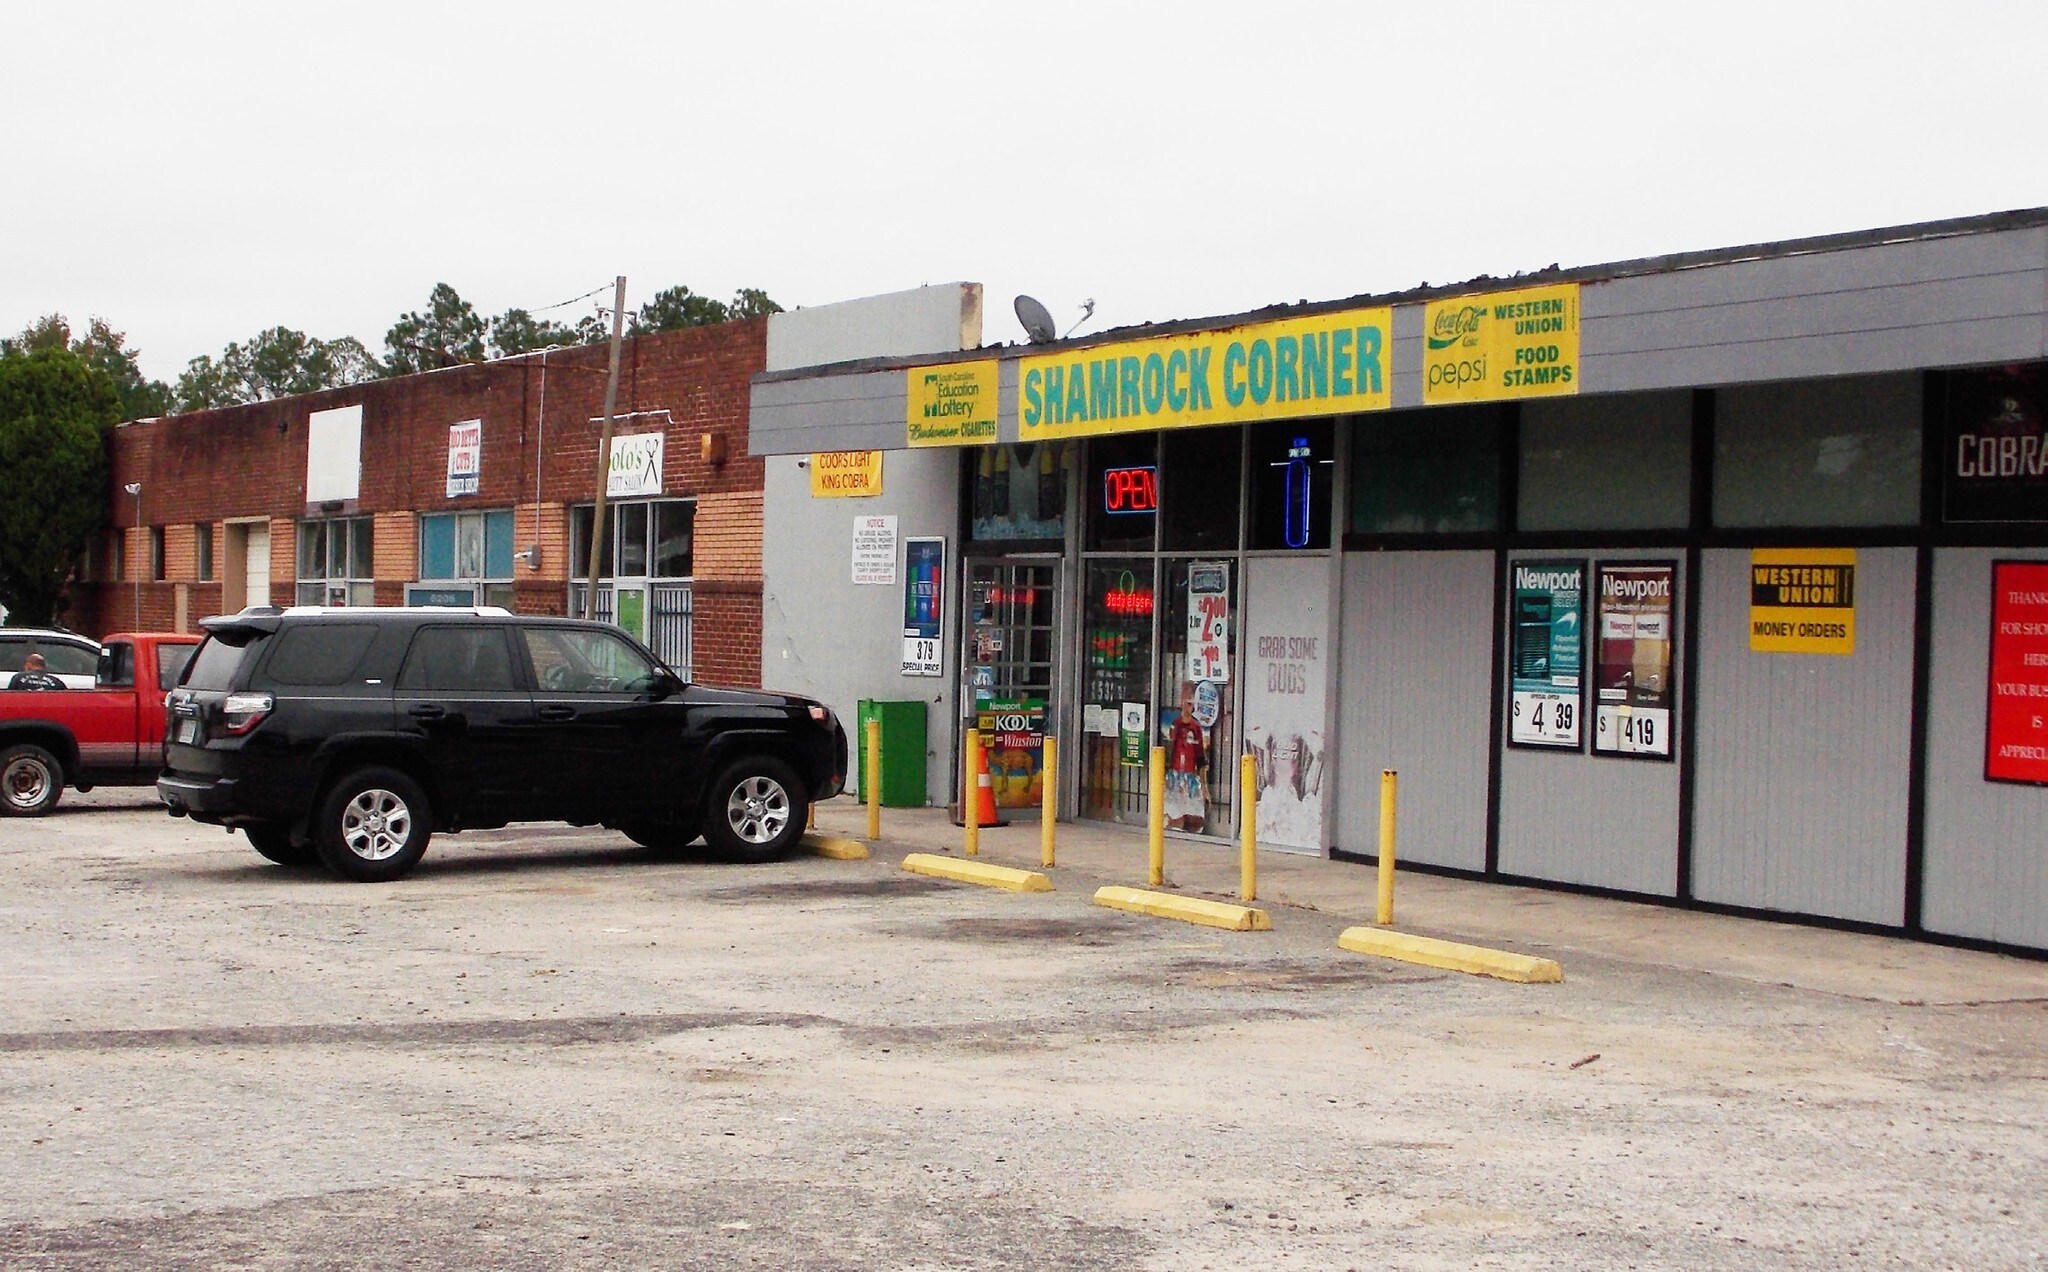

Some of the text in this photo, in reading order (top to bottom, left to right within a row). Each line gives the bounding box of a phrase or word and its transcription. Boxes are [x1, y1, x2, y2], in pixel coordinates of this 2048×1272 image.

[1494, 298, 1563, 319] WESTERN
[1515, 316, 1563, 335] UNION
[1515, 344, 1559, 365] FOOD
[1024, 324, 1383, 427] SHAMROCK CORNER
[1428, 353, 1487, 392] pepsi
[1503, 365, 1572, 387] STAMPS
[938, 382, 979, 397] Education
[938, 399, 975, 419] Lottery
[607, 442, 642, 471] olo's
[819, 452, 872, 469] COORS LIGHT
[821, 473, 869, 489] KING COBRA
[1108, 470, 1157, 509] OPEN
[866, 519, 884, 528] NOTICE
[1516, 567, 1581, 594] Newport
[1754, 568, 1836, 585] WESTERN
[1602, 574, 1670, 601] Newport
[1778, 586, 1835, 603] UNION
[1553, 598, 1578, 607] SELECT
[1636, 621, 1660, 631] Newport
[1753, 621, 1846, 638] MONEY ORDERS
[2000, 621, 2022, 635] FOR
[1259, 636, 1319, 660] GRAB SOME
[902, 661, 940, 672] SPECIAL PRICE
[1267, 662, 1306, 694] BUDS
[1997, 682, 2027, 696] YOUR
[989, 701, 1022, 711] Newport
[1513, 700, 1521, 717] $
[996, 714, 1034, 731] KOOL
[1599, 716, 1606, 732] $
[2031, 715, 2043, 728] IS
[1003, 732, 1042, 748] Winston
